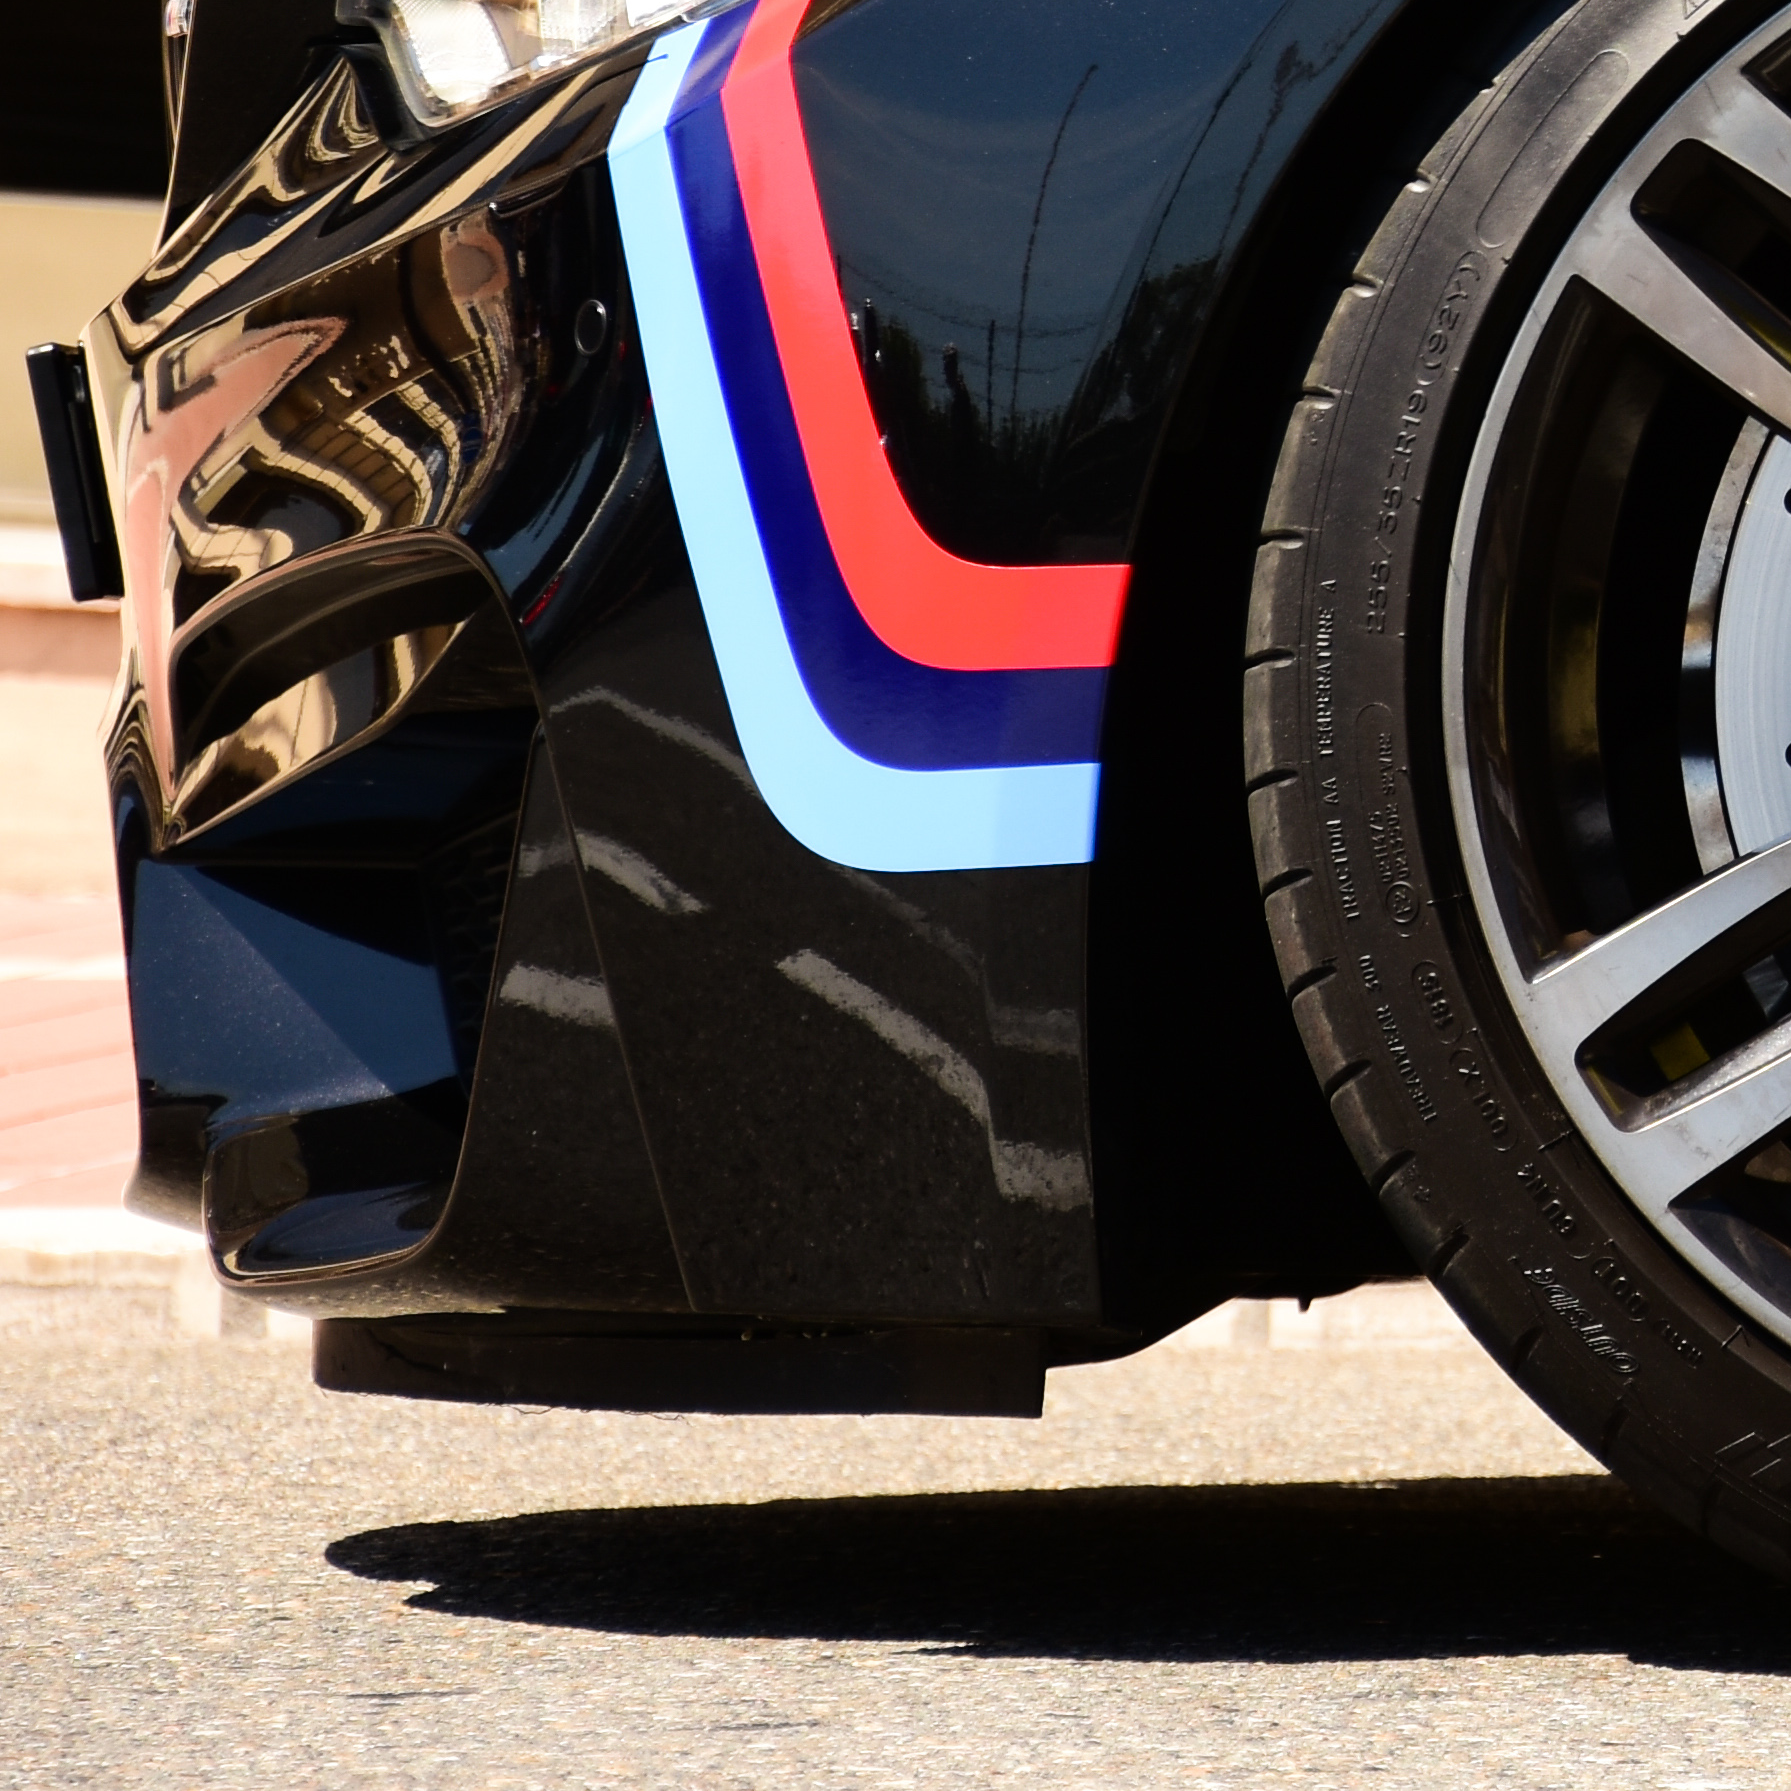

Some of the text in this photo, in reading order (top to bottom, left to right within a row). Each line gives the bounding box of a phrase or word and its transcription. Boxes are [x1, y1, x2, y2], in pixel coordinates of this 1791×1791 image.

[1314, 605, 1335, 757] TEMPERATURE
[1319, 773, 1340, 807] AA
[1325, 815, 1363, 922] TRACTION
